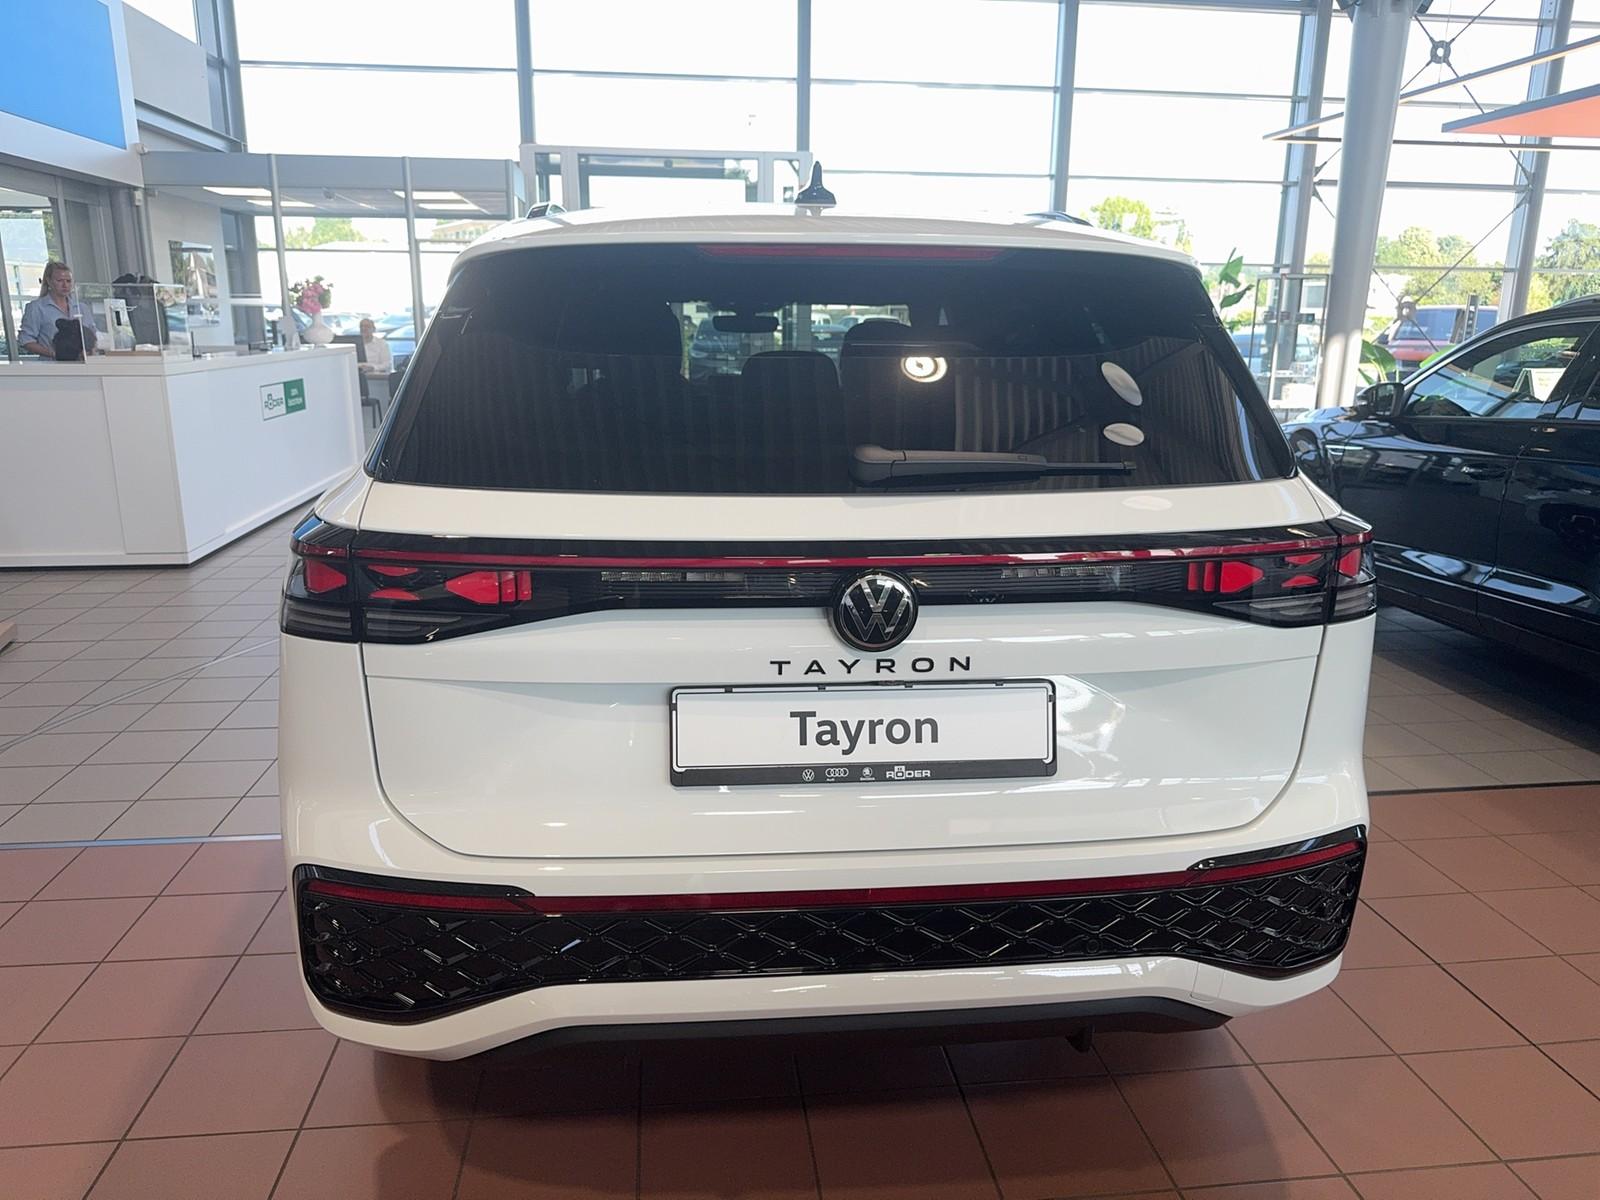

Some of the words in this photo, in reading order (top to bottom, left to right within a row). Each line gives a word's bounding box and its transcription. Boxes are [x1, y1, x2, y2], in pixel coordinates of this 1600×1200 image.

[770, 656, 971, 676] TAYRON
[790, 710, 939, 756] Tayron
[886, 765, 931, 780] RÖDER
